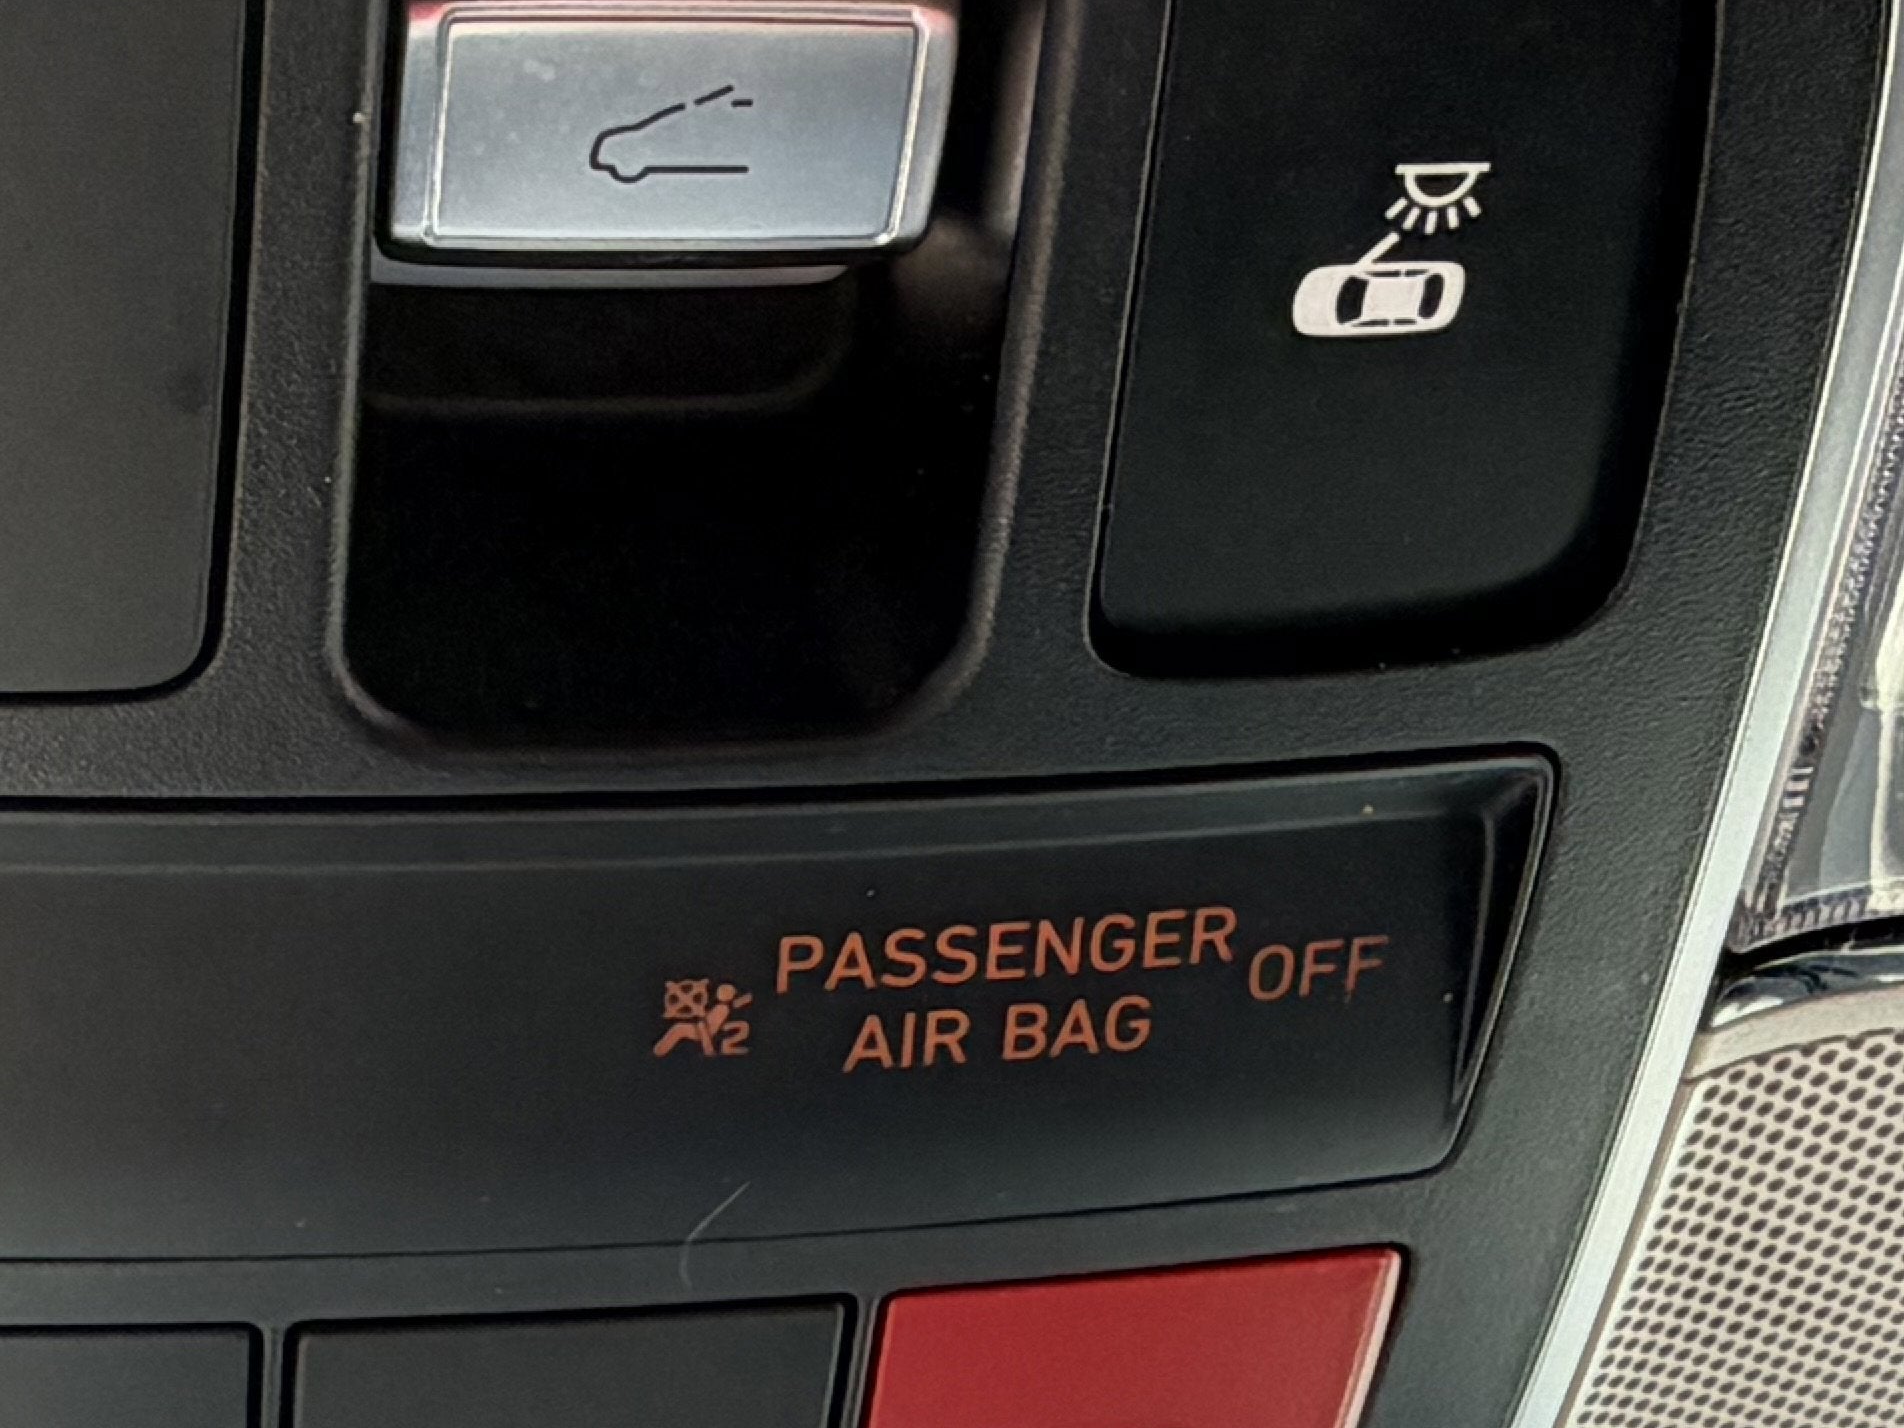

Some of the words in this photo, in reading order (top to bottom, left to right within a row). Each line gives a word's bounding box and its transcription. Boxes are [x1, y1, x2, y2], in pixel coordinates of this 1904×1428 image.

[776, 906, 1239, 994] PASSENGER
[1249, 935, 1389, 1001] OFF
[844, 1008, 972, 1072] AIR
[1002, 994, 1154, 1061] BAG
